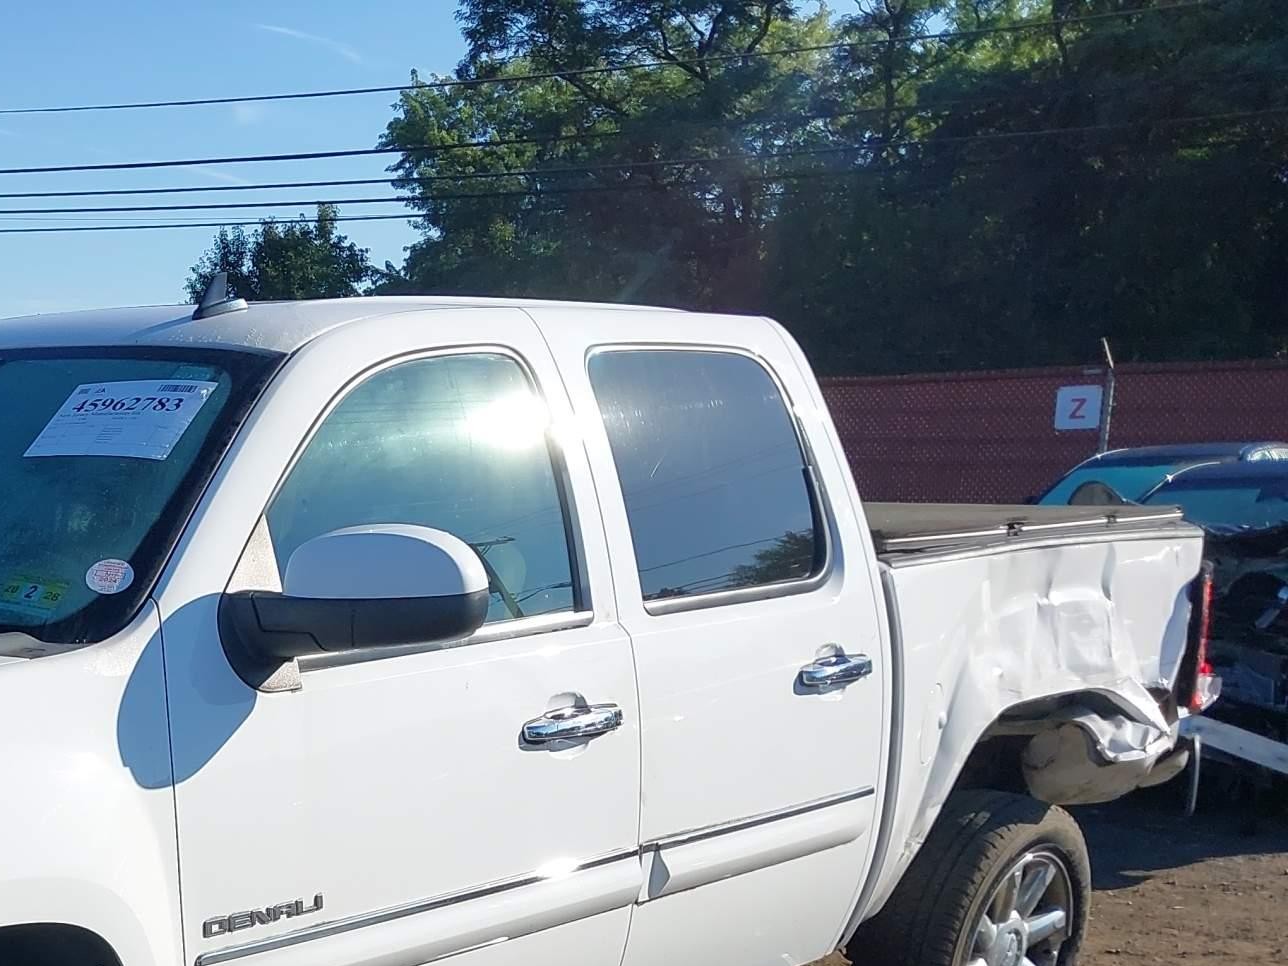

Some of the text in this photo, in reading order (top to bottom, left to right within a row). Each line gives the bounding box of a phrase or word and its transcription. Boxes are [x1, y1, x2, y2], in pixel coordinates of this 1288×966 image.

[72, 397, 184, 413] 45962783
[1068, 397, 1087, 420] Z
[202, 893, 324, 938] DENALI
